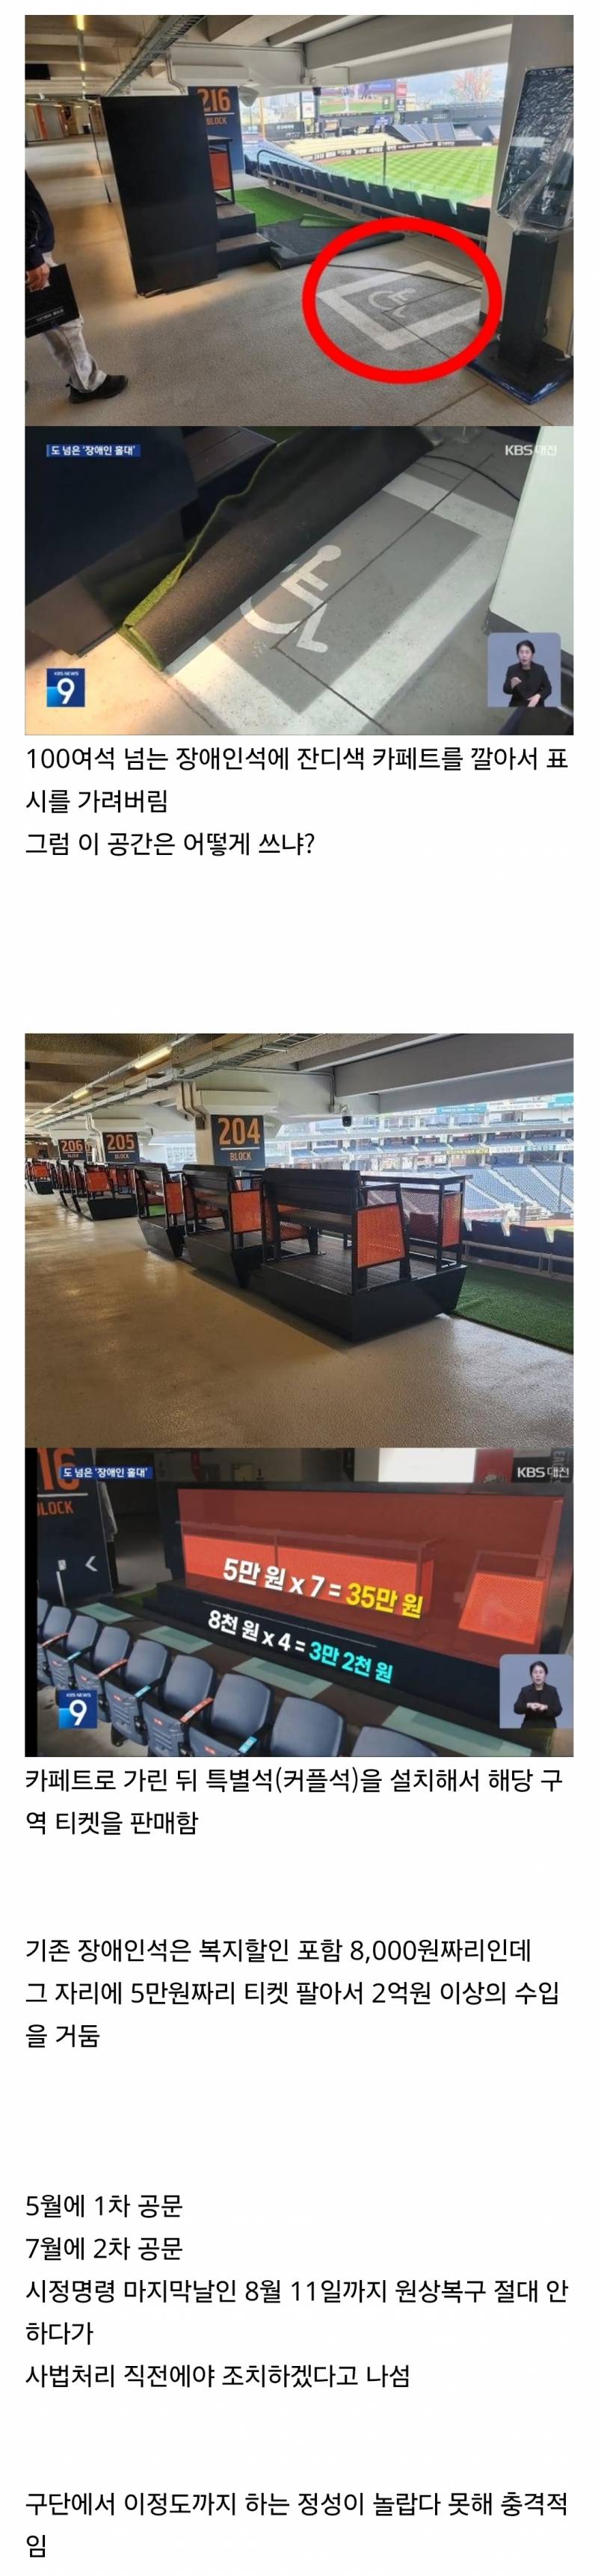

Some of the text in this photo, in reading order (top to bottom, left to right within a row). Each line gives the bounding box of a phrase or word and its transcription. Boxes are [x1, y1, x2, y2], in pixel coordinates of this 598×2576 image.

[197, 87, 231, 112] 216
[206, 117, 227, 126] BLOCK
[218, 1117, 261, 1146] 204
[61, 1140, 83, 1152] 206
[106, 1134, 135, 1150] 205
[229, 1152, 251, 1161] BLOCK
[37, 1448, 80, 1490] 16
[37, 1501, 73, 1516] LOCK
